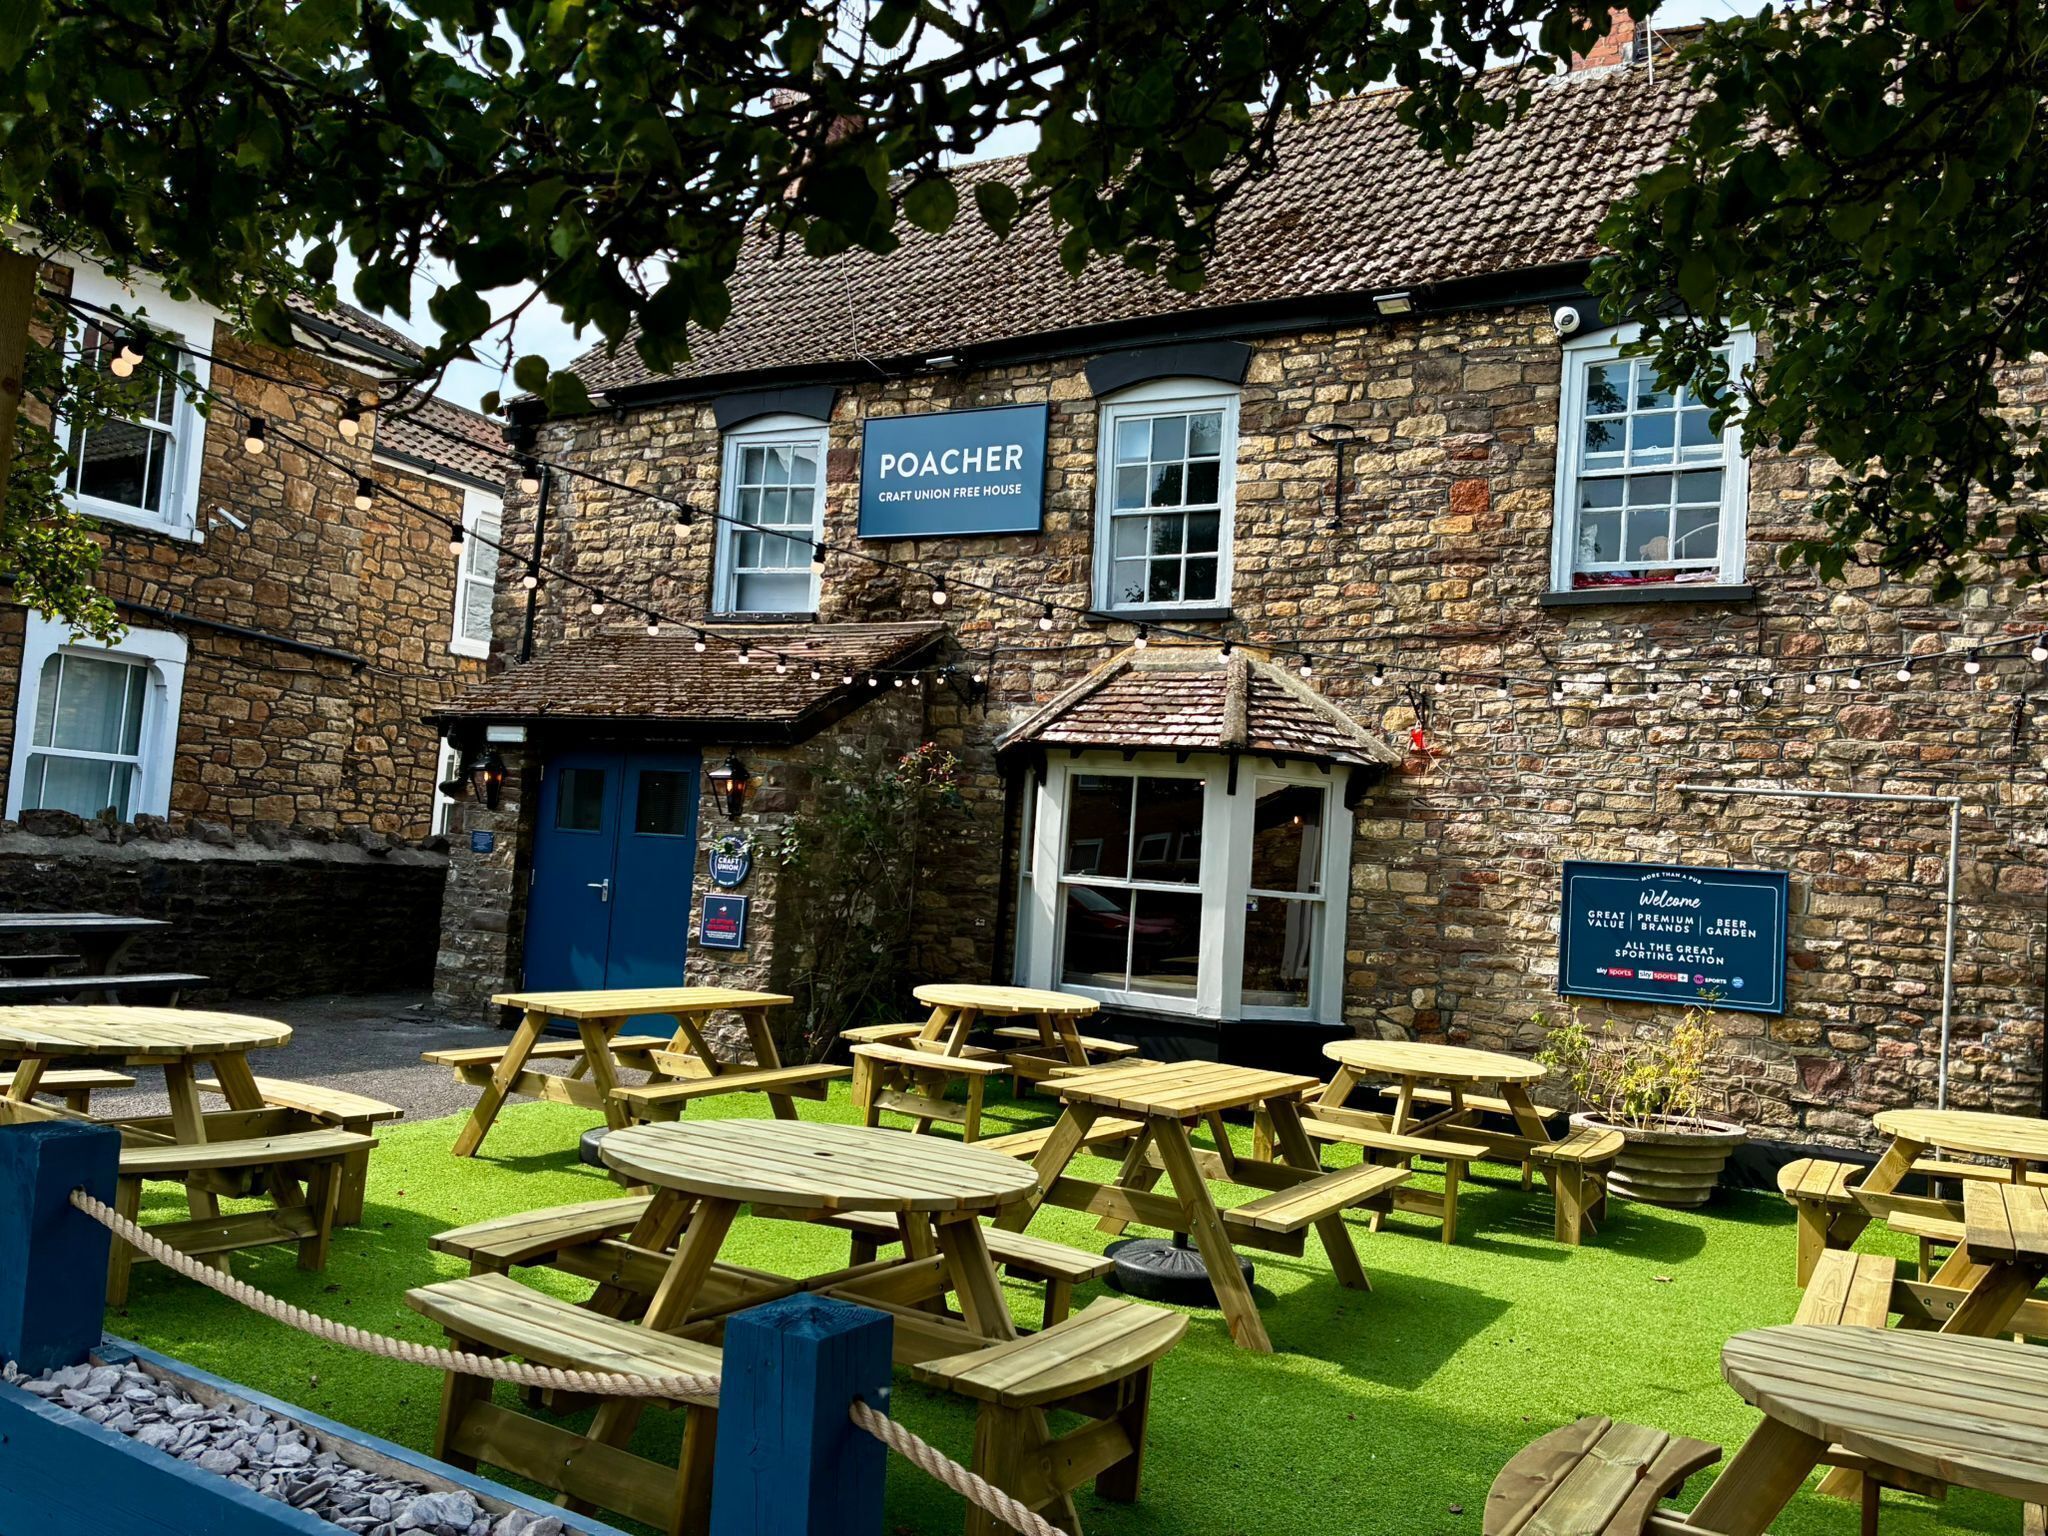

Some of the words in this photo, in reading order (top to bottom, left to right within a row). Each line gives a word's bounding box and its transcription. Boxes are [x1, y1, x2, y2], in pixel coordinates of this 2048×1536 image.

[880, 444, 1023, 479] POACHER
[878, 490, 912, 502] CRAFT
[914, 488, 950, 500] UNION
[953, 486, 980, 498] FREE
[983, 483, 1021, 496] HOUSE
[718, 857, 739, 865] CRAFT
[717, 863, 739, 871] UNION
[1641, 872, 1660, 882] MORE
[1688, 875, 1702, 885] PUB
[1639, 889, 1702, 908] Welcome
[1588, 910, 1625, 920] GREAT
[1637, 913, 1694, 924] PREMIUM
[1588, 919, 1625, 929] VALUE
[1641, 923, 1690, 933] BRANDS
[1716, 918, 1747, 928] BEER
[1706, 926, 1757, 938] GARDEN
[1624, 941, 1645, 950] ALL
[1649, 943, 1671, 952] THE
[1676, 945, 1714, 955] GREAT
[1615, 949, 1674, 961] SPORTING
[1678, 955, 1724, 965] ACTION
[1596, 967, 1608, 975] sky
[1609, 969, 1632, 977] sports
